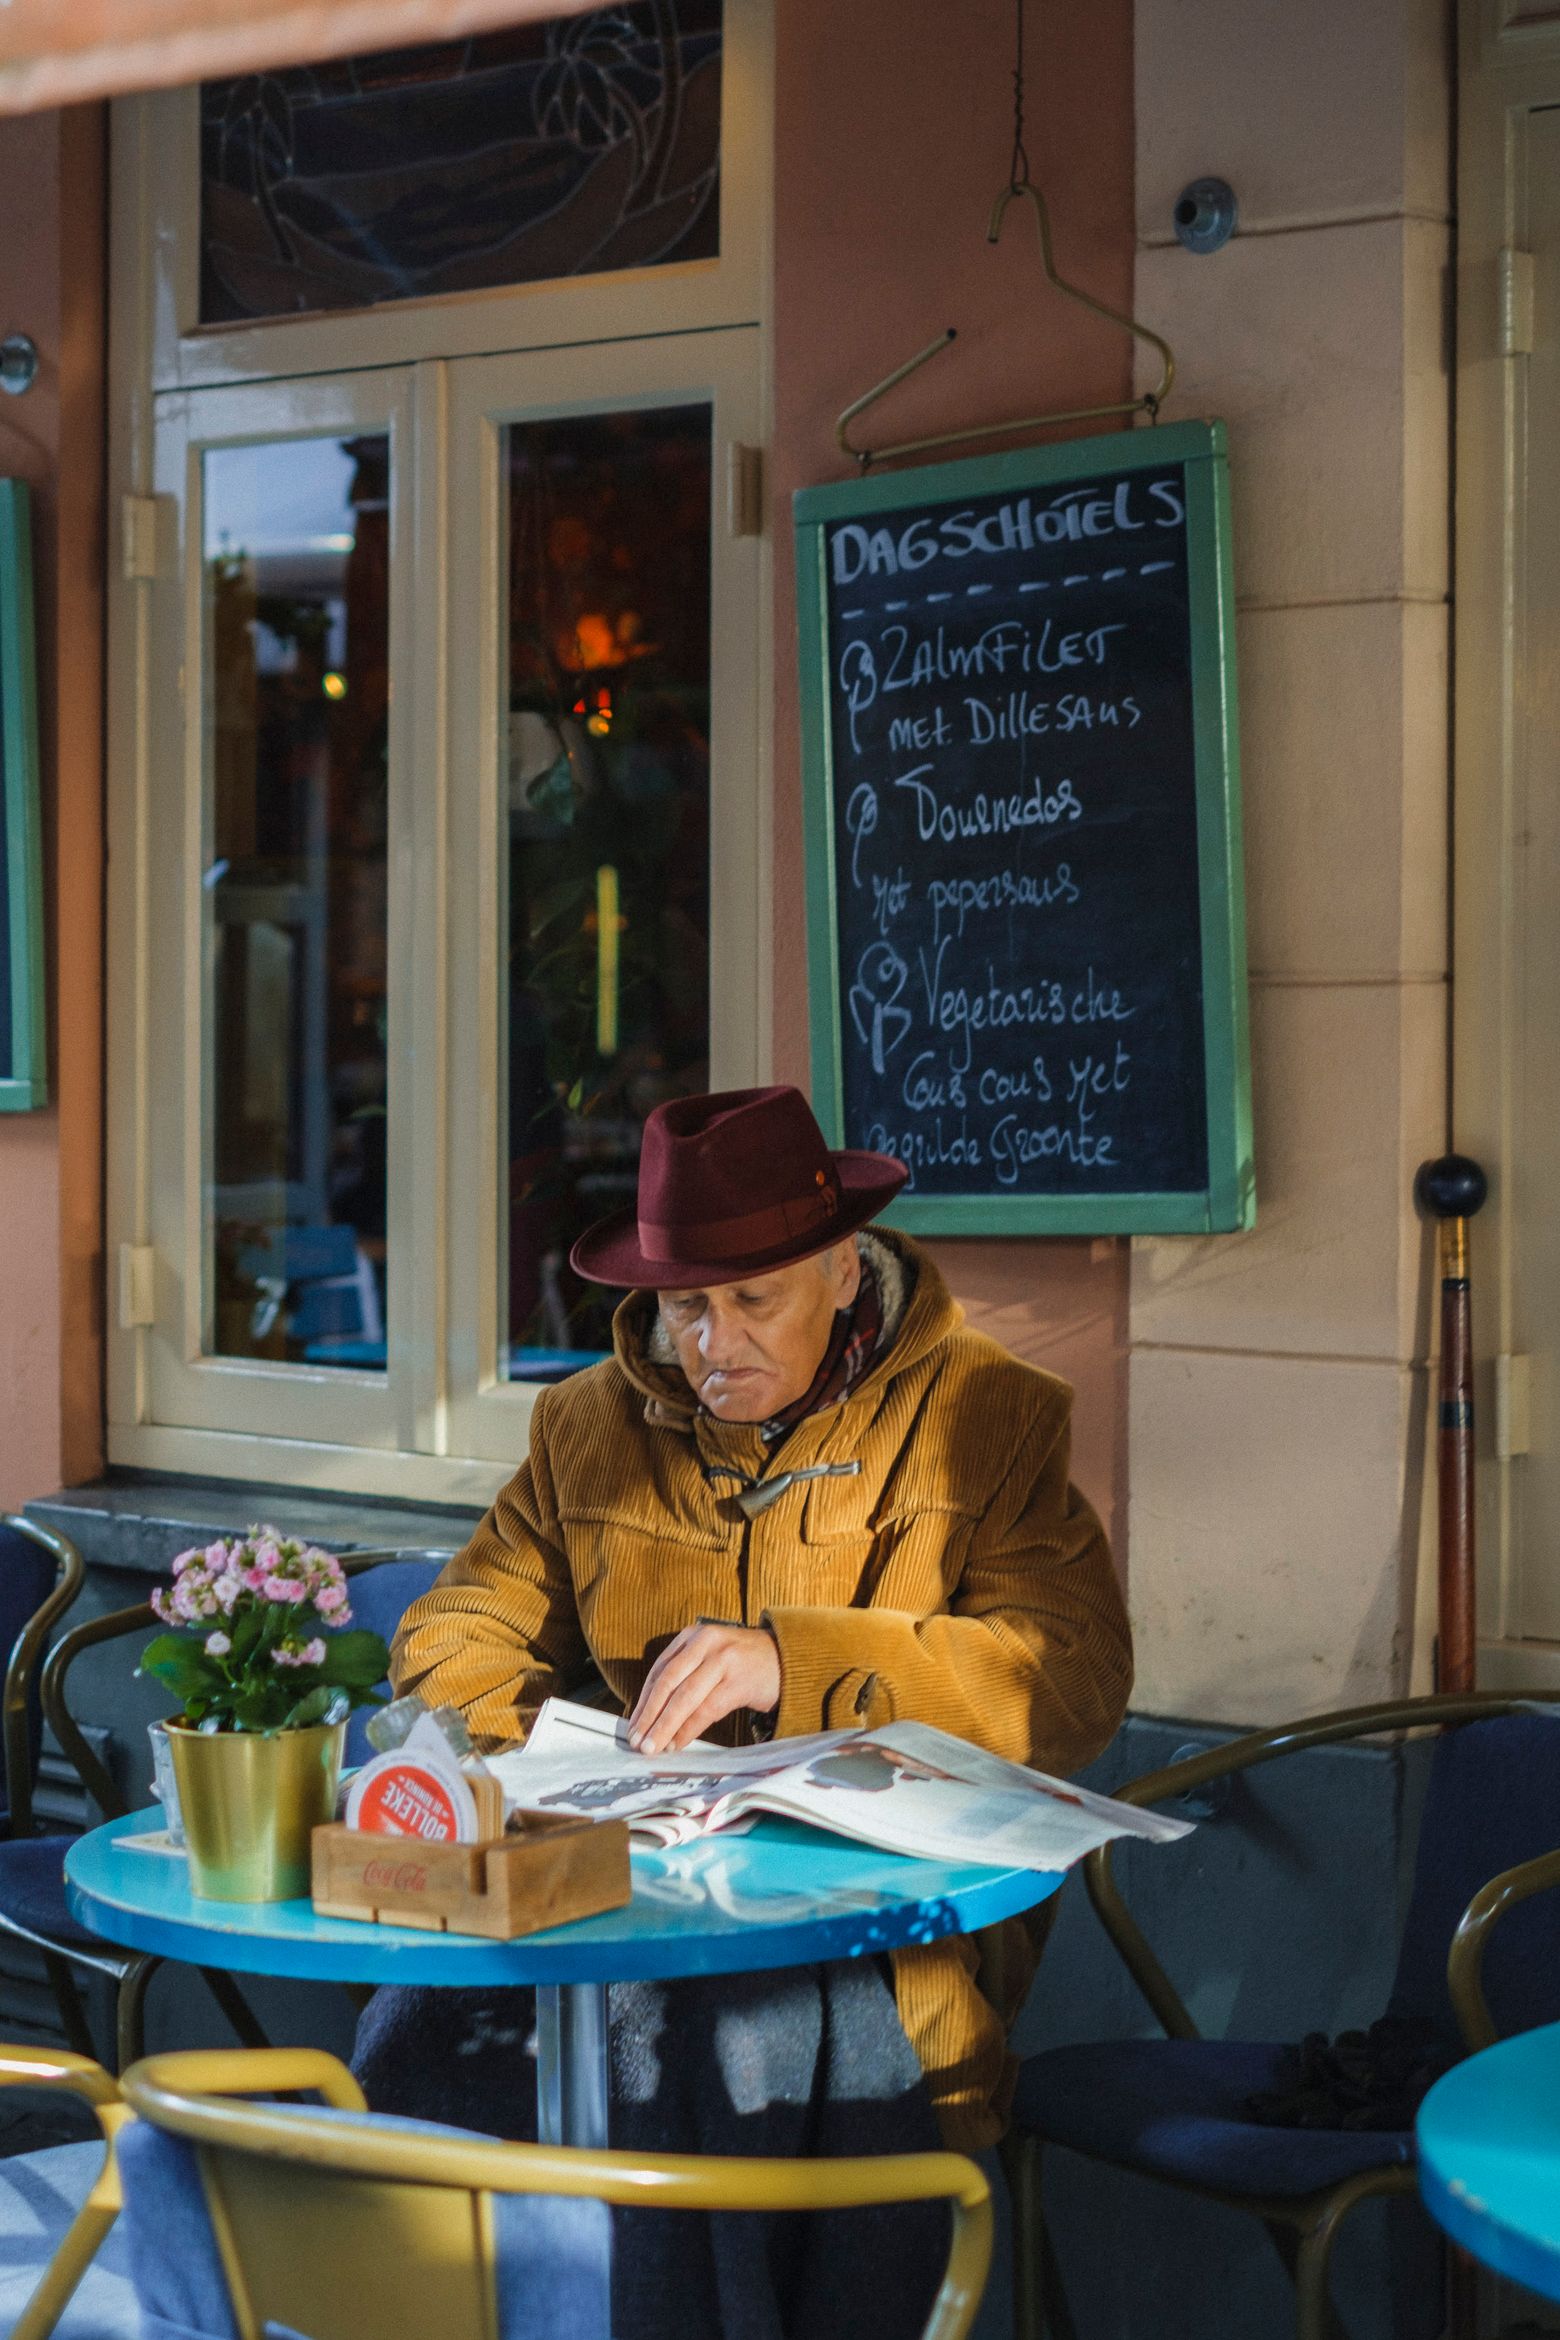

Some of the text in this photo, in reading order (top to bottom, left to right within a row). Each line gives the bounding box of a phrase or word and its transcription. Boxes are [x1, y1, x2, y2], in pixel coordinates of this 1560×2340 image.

[831, 481, 1185, 585] DAGSCHOTELS
[918, 934, 1137, 1074] Vegetarische
[380, 1780, 448, 1840] BOLLEKE
